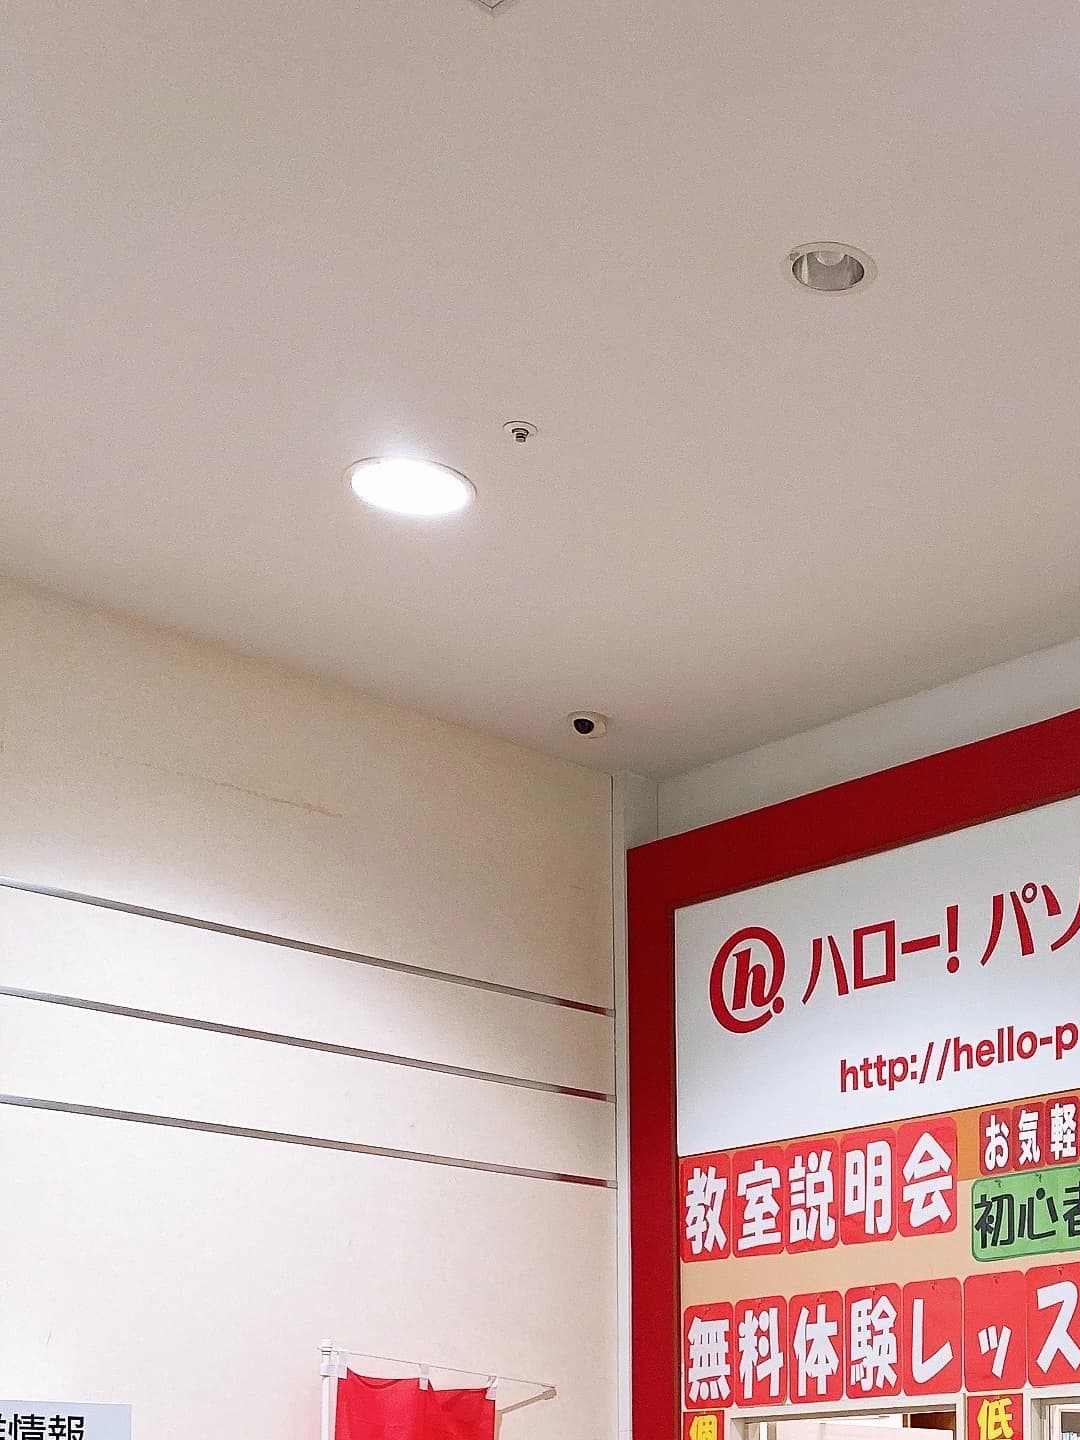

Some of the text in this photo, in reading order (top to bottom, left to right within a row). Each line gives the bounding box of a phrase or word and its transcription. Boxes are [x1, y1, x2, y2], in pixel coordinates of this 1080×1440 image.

[801, 905, 961, 1004] ハロー!
[685, 1132, 954, 1255] 教室説明会
